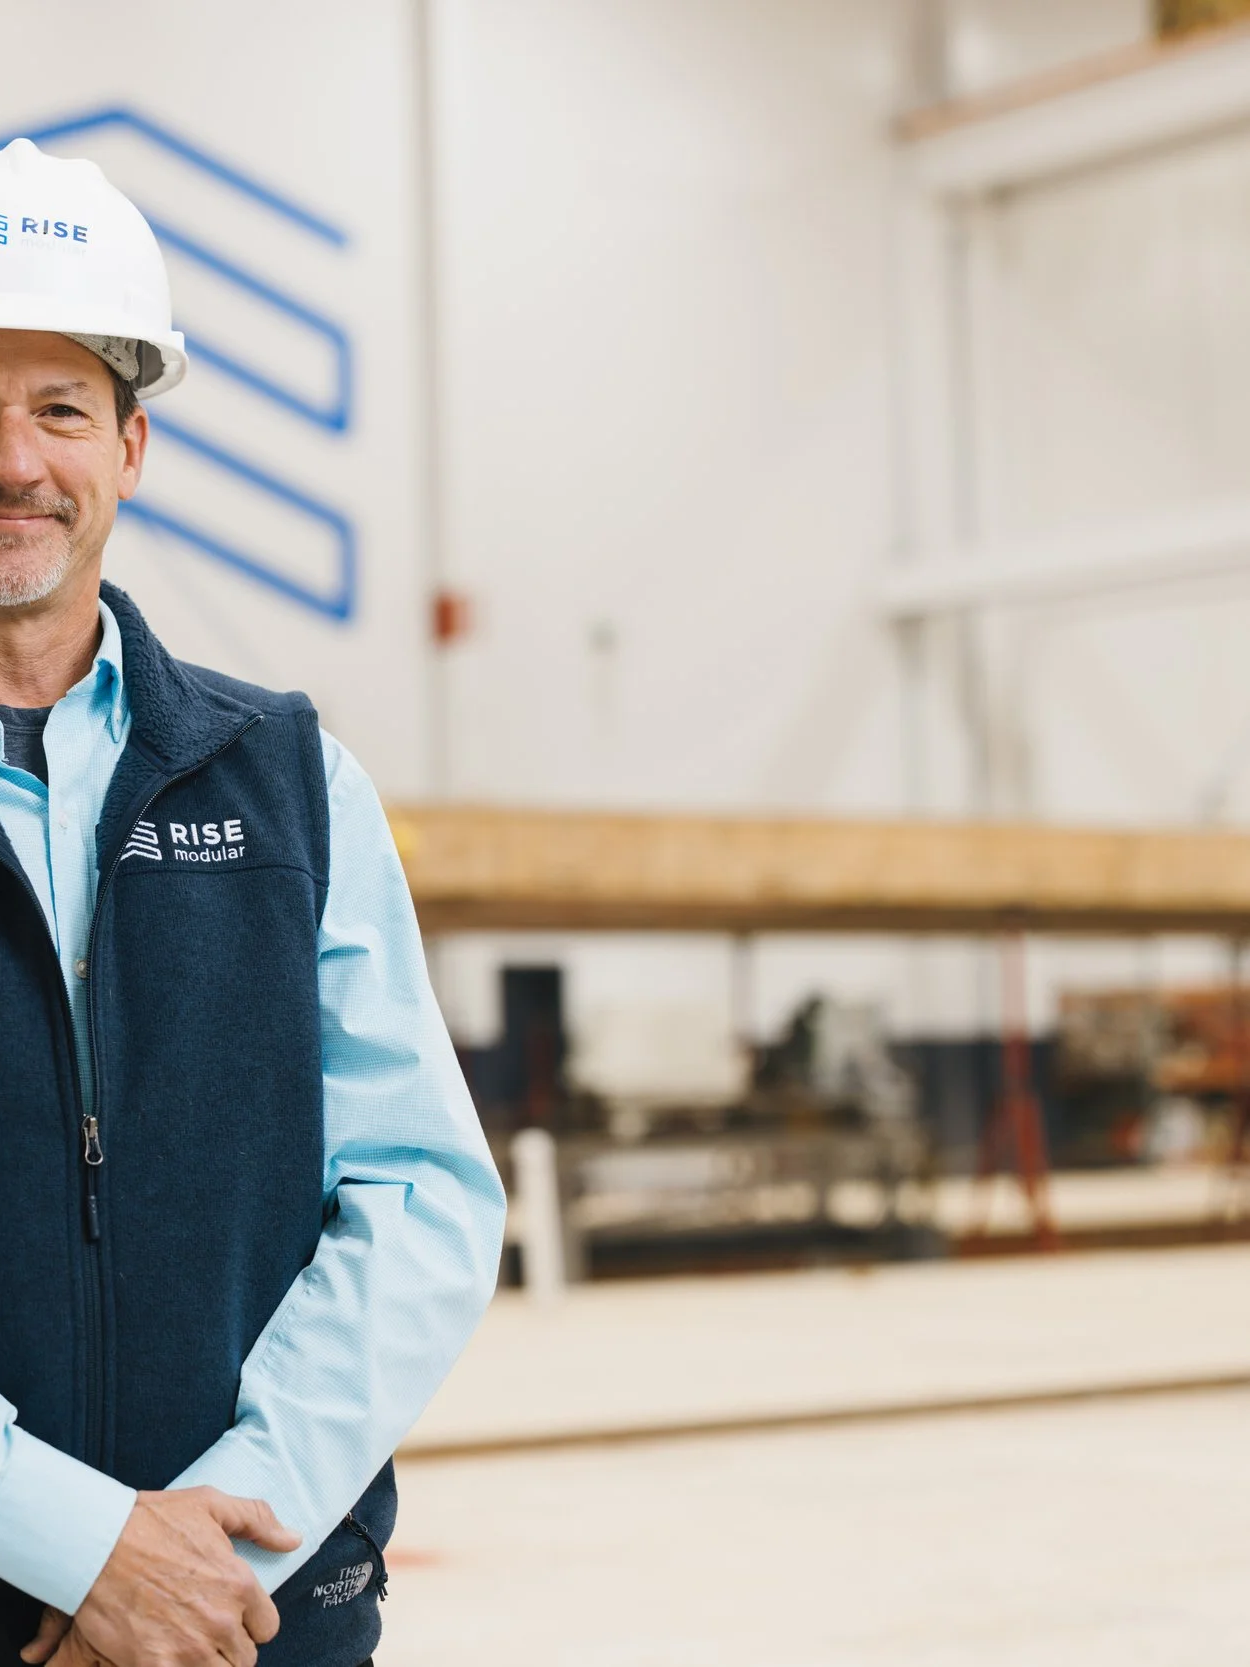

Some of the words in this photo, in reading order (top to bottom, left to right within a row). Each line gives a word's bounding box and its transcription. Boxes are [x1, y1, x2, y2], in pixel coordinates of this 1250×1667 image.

[21, 217, 88, 243] RISE
[170, 819, 244, 845] RISE
[174, 845, 245, 862] modular
[339, 1563, 363, 1580] THE
[313, 1578, 359, 1597] NORTH
[323, 1590, 355, 1608] FACE
